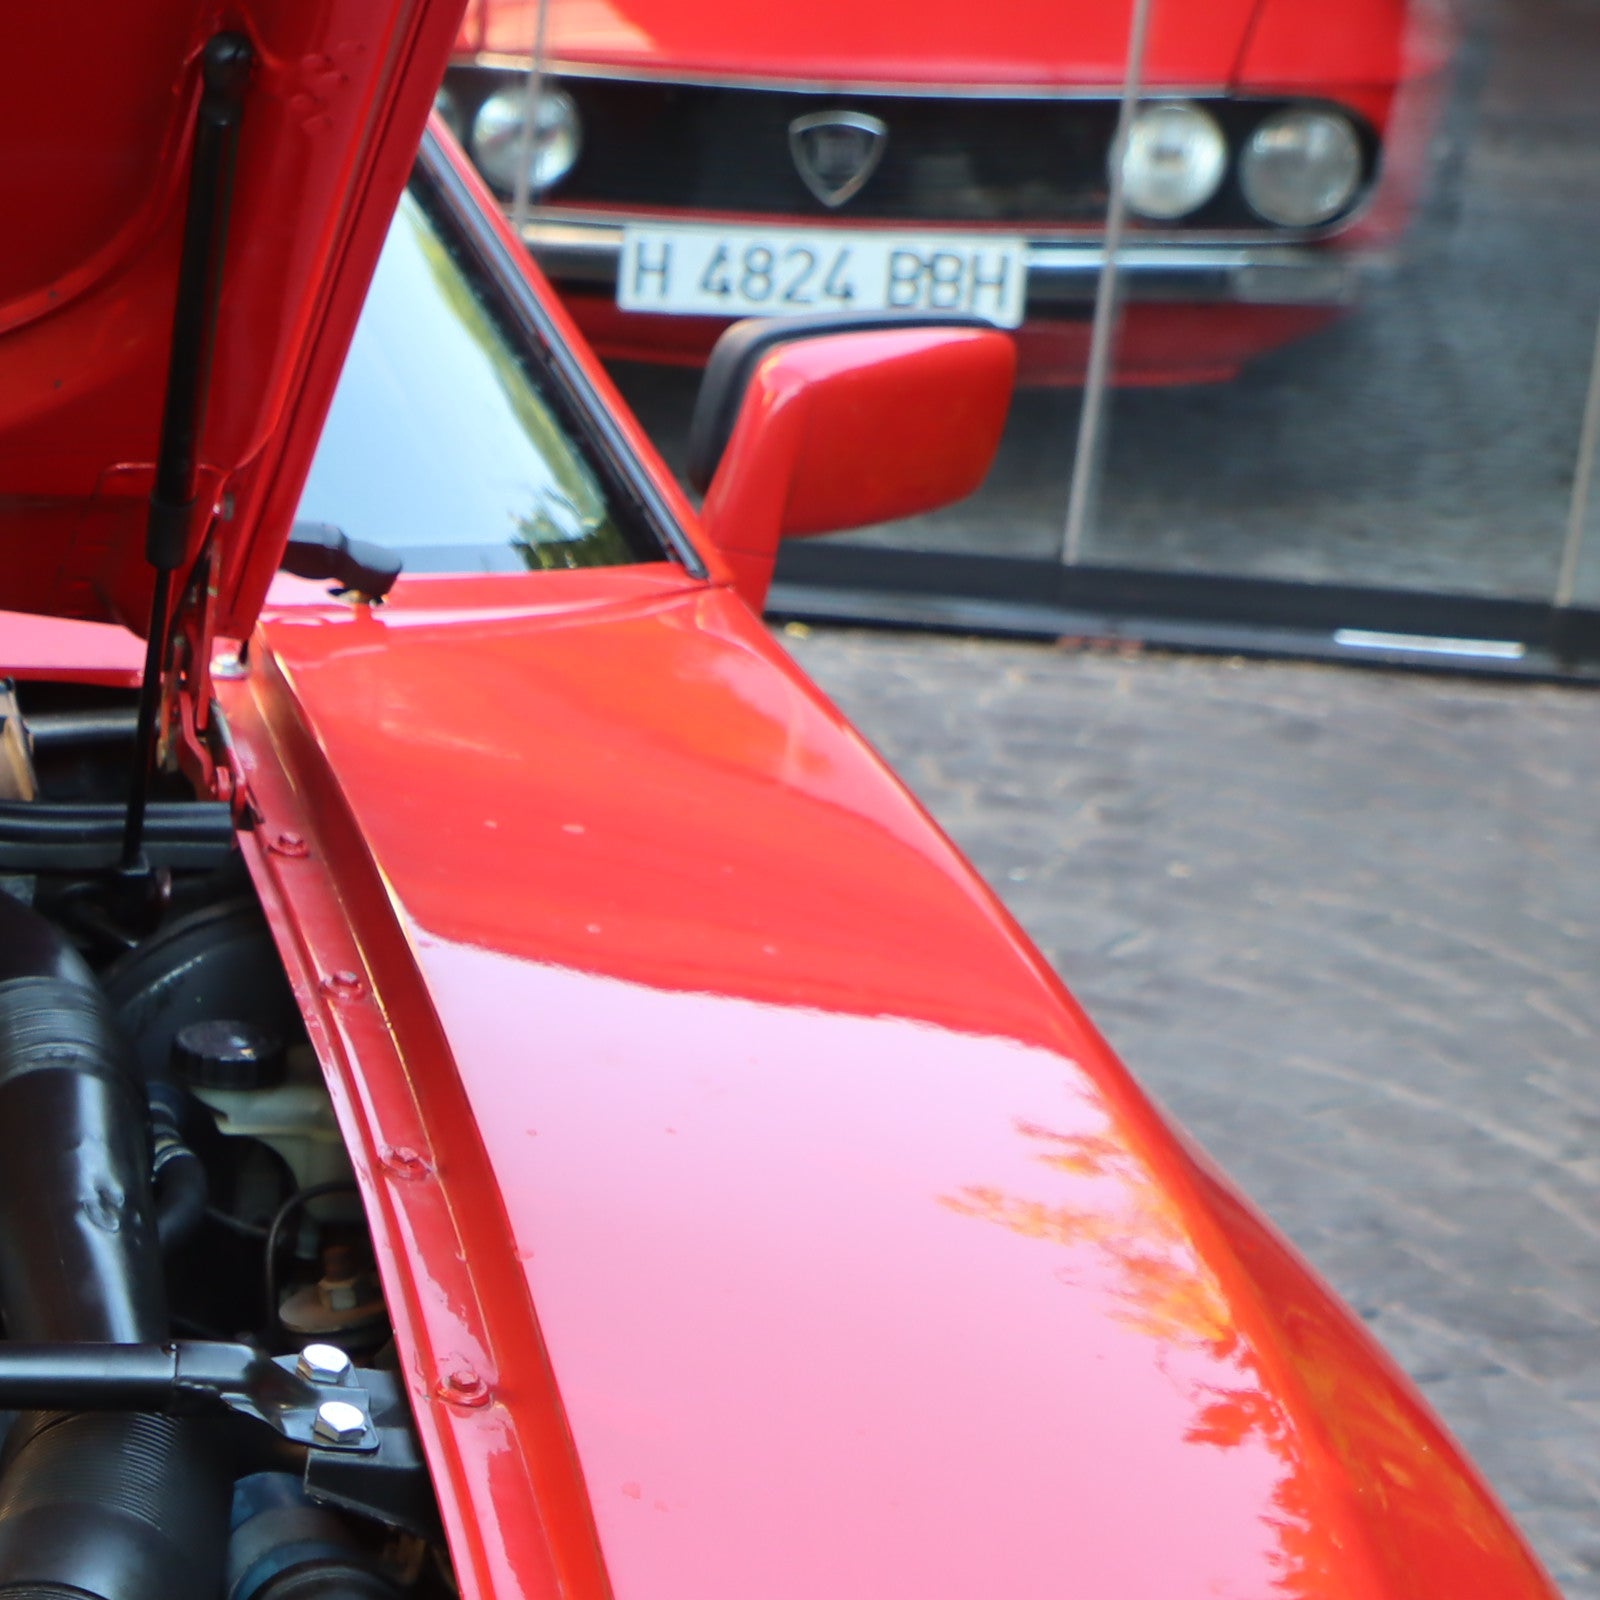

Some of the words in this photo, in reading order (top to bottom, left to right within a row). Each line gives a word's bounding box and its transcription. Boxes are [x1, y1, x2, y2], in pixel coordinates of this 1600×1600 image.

[635, 241, 672, 297] H
[701, 243, 854, 304] 4824
[885, 249, 1010, 309] BBH
